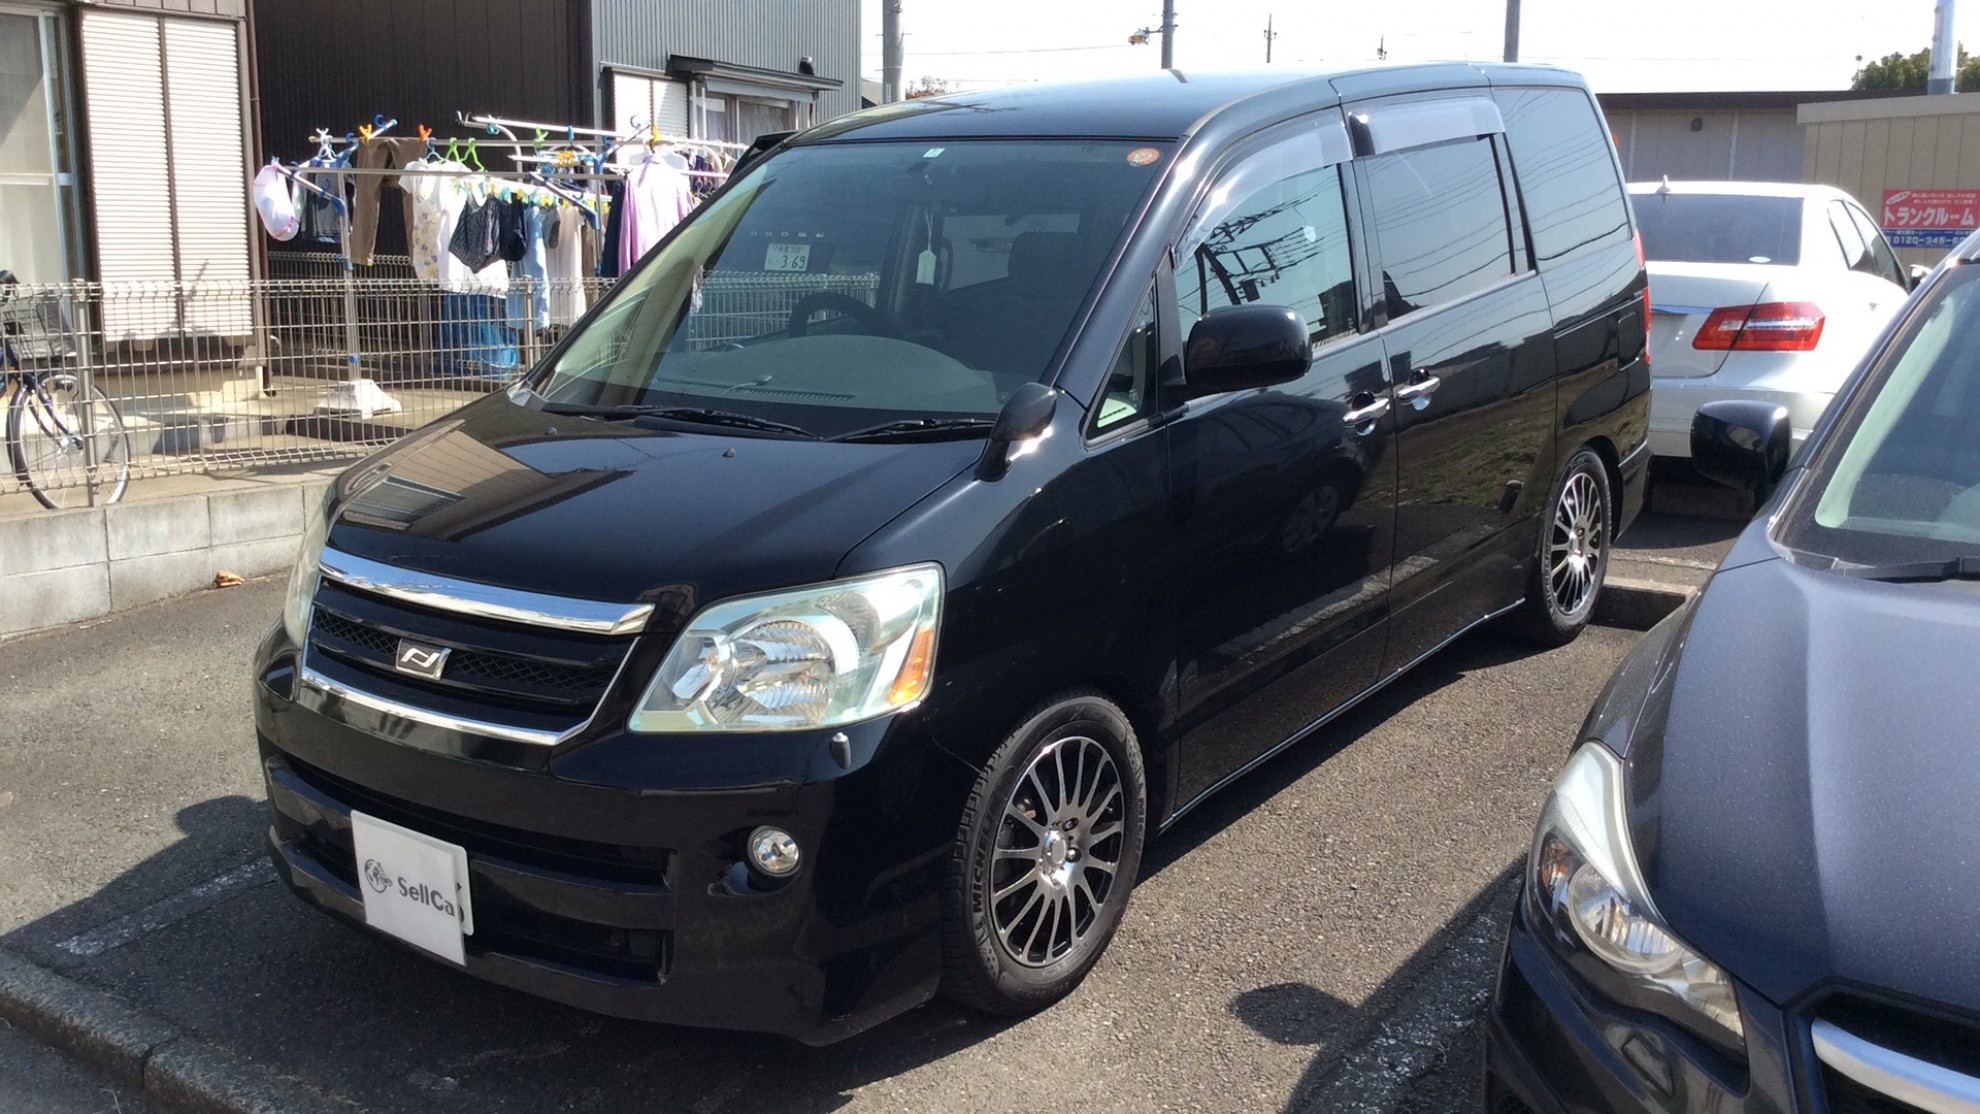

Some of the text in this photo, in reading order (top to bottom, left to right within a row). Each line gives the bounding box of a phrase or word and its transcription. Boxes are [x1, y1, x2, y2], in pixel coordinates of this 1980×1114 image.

[1884, 206, 1975, 226] トランクルーム
[398, 877, 455, 917] SellCa
